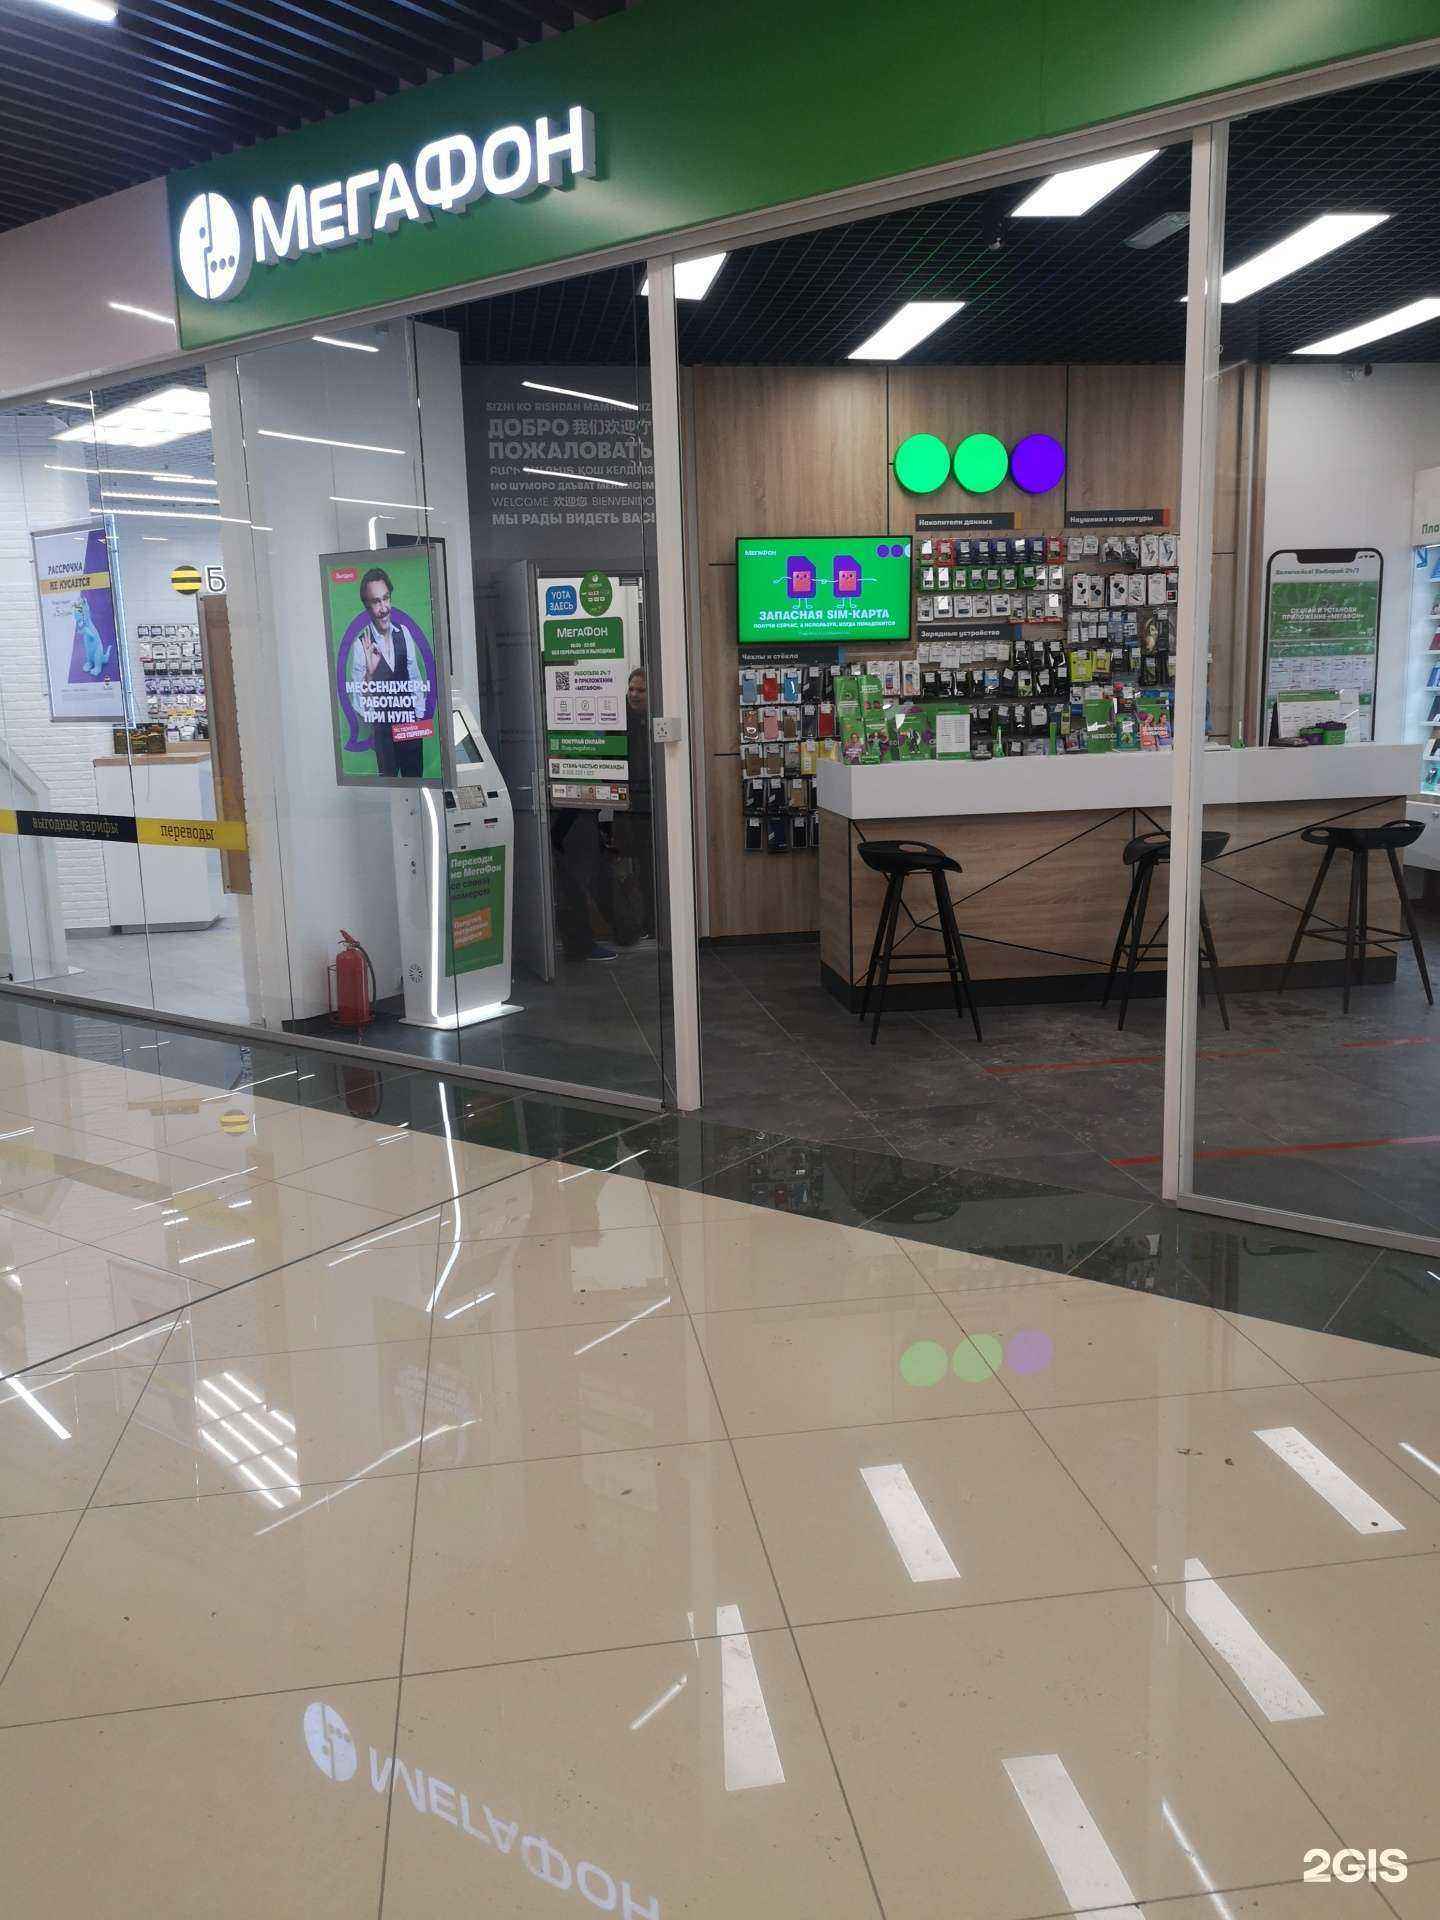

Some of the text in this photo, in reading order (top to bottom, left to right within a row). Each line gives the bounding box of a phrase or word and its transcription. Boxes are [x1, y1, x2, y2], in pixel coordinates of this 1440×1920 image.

[252, 105, 585, 263] МЕГАФОН
[488, 418, 569, 438] ДОБРО
[488, 441, 652, 459] ПОЖАЛОВАТЬ
[492, 496, 548, 508] WELCOME
[492, 512, 656, 526] МЫ РАДЫ ВИДЕТЬ ВАС!
[550, 602, 574, 611] ЗДЕСЬ
[759, 609, 823, 621] ЗАПАСНАЯ
[346, 680, 430, 693] МЕССЕНДЖЕРЫ
[360, 696, 416, 708] РАБОТАЮТ
[363, 710, 415, 723] ПРИ НУЛЕ
[32, 817, 119, 839] выгодные тарифы
[160, 824, 215, 841] переводы
